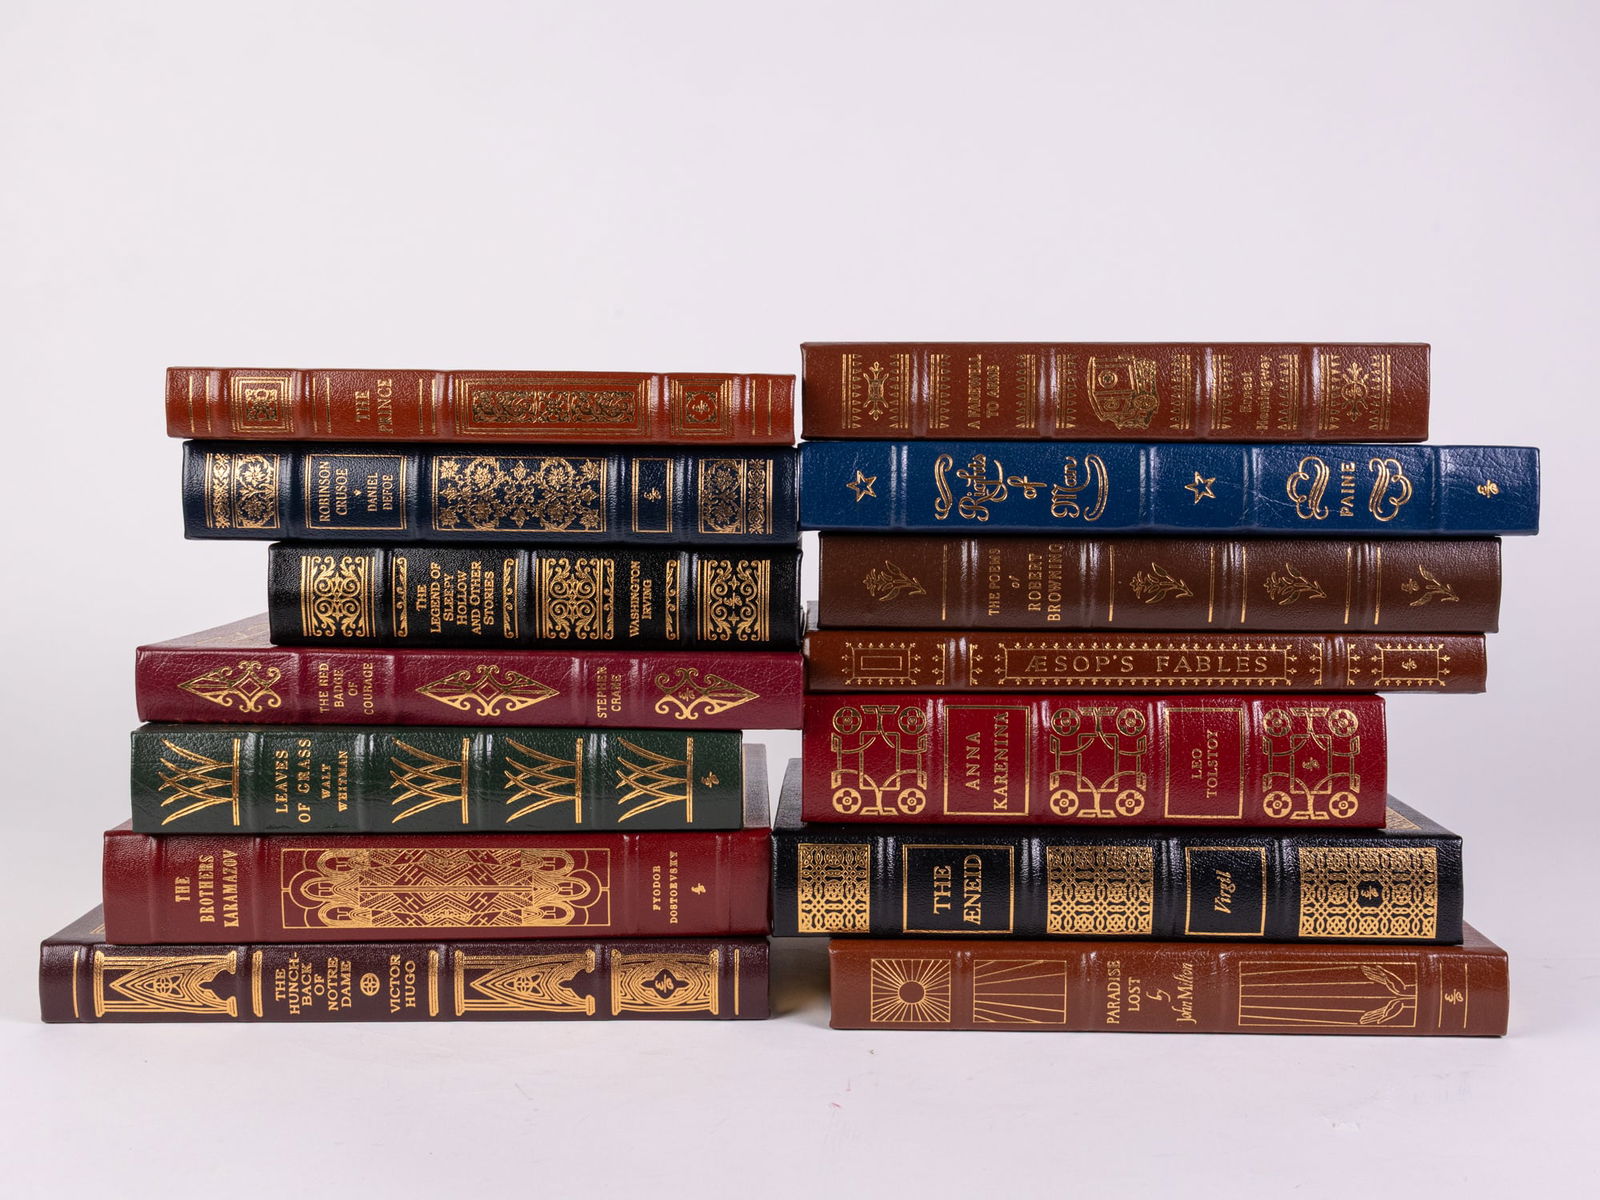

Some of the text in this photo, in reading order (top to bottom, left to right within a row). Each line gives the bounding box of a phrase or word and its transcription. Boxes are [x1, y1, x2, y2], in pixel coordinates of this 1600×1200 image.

[355, 390, 370, 422] THE
[377, 378, 393, 434] PRINCE
[968, 354, 981, 430] A FAREWELL
[986, 365, 1000, 418] TO ARMS
[319, 461, 331, 522] ROBINSON
[336, 468, 348, 516] CRUSOE
[367, 472, 377, 512] DANIEL
[382, 474, 393, 510] DEFOE
[957, 454, 1008, 521] Rights
[1007, 476, 1047, 499] of
[1051, 456, 1092, 518] Man
[1340, 462, 1356, 516] PAINE
[416, 584, 427, 611] THE
[430, 562, 441, 633] LEGEND OF
[443, 573, 454, 621] SLEEPY
[457, 570, 467, 625] HOLLOW
[470, 561, 481, 635] AND OTHER
[484, 571, 494, 625] STORIES
[629, 561, 640, 637] WASHINGTON
[642, 579, 652, 620] IRVING
[988, 548, 1000, 616] THE POEMS
[1008, 575, 1020, 588] of
[1028, 553, 1042, 611] ROBERT
[1047, 544, 1062, 621] BROWNING
[319, 663, 329, 713] THE RED
[334, 670, 344, 707] BADGE
[348, 682, 358, 696] OF
[363, 663, 374, 715] COURAGE
[1156, 656, 1268, 672] FABLES
[597, 667, 607, 718] STEPHEN
[611, 674, 621, 712] CRANE
[275, 750, 288, 813] LEAVES
[297, 739, 311, 823] OF GRASS
[321, 764, 331, 799] WALT
[338, 751, 348, 812] WHITMAN
[965, 732, 981, 791] ANNA
[993, 712, 1008, 810] KARENINA
[1192, 748, 1202, 779] LEO
[1207, 729, 1218, 798] TOLSTOY
[175, 876, 190, 902] THE
[198, 855, 215, 922] BROTHERS
[223, 849, 239, 927] KARAMAZOV
[653, 865, 661, 911] FYODOR
[670, 851, 678, 924] DOSTOEVSKY
[933, 866, 951, 915] THE
[964, 854, 982, 925] ÆNEID
[1214, 869, 1236, 914] Virgil
[275, 969, 286, 1001] THE
[288, 952, 300, 1015] HUNCH-
[301, 963, 312, 1006] BACK
[314, 974, 324, 995] OF
[327, 957, 338, 1011] NOTRE
[341, 960, 352, 1008] DAME
[390, 954, 401, 1013] VICTOR
[405, 960, 416, 1008] HUGO
[1107, 960, 1121, 1024] PARADISE
[1128, 977, 1140, 1012] LOST
[1146, 988, 1171, 1002] by
[1172, 963, 1197, 1024] John Milton
